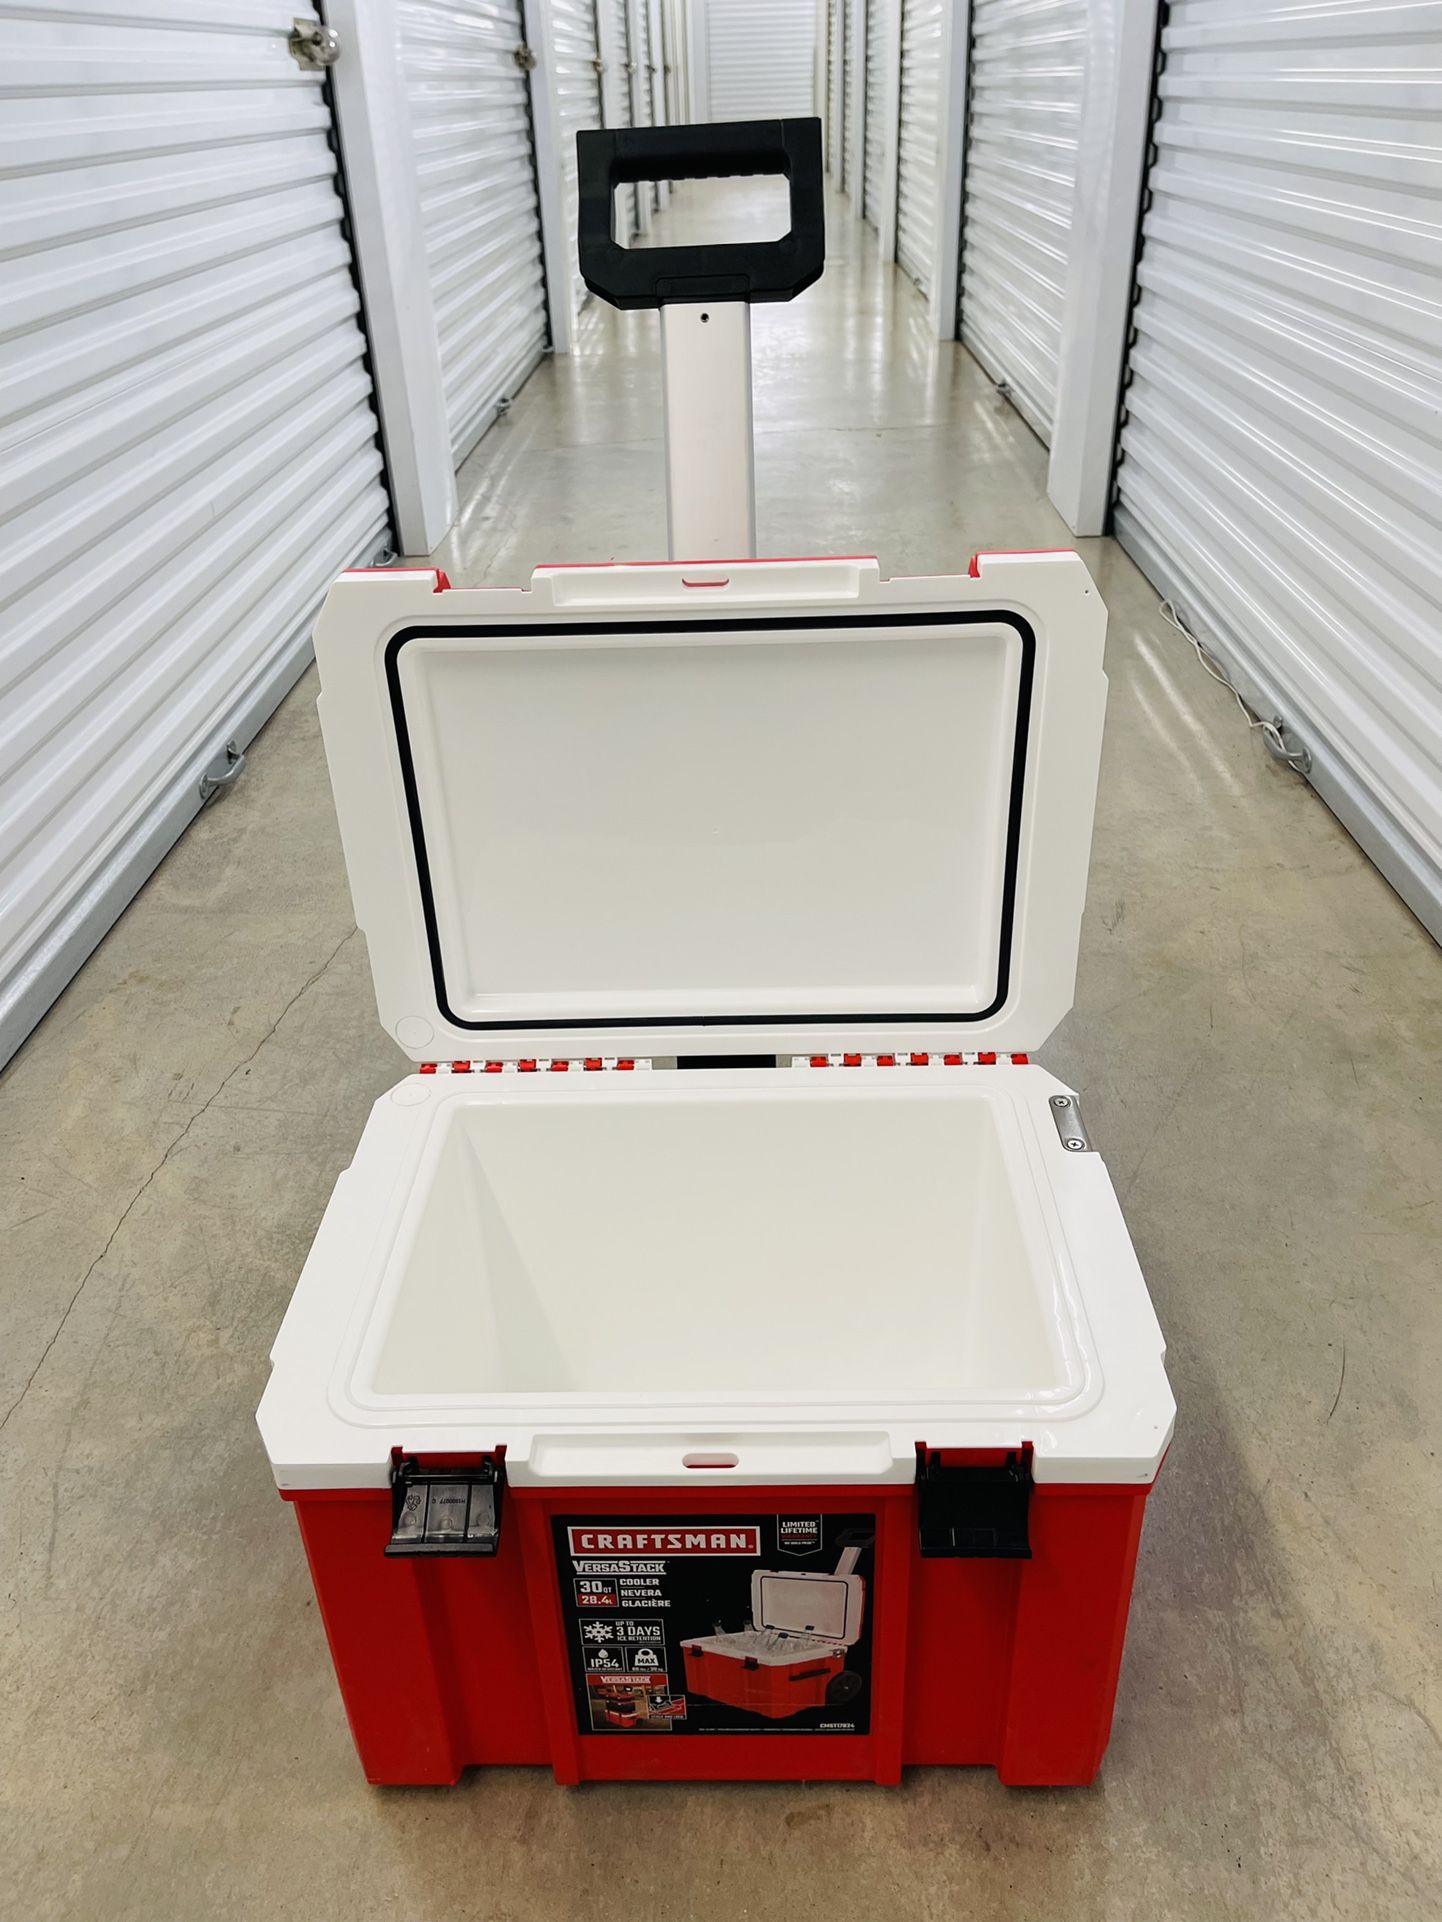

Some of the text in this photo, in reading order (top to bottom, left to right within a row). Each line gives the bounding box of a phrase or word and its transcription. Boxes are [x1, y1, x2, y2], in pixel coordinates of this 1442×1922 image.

[581, 1534, 747, 1549] CRAFTSMAN
[620, 1578, 660, 1586] COOLER
[621, 1589, 662, 1597] NEVERA
[622, 1598, 671, 1607] GLACIÈRE
[616, 1626, 661, 1636] 3 DAYS
[590, 1658, 620, 1668] IP54
